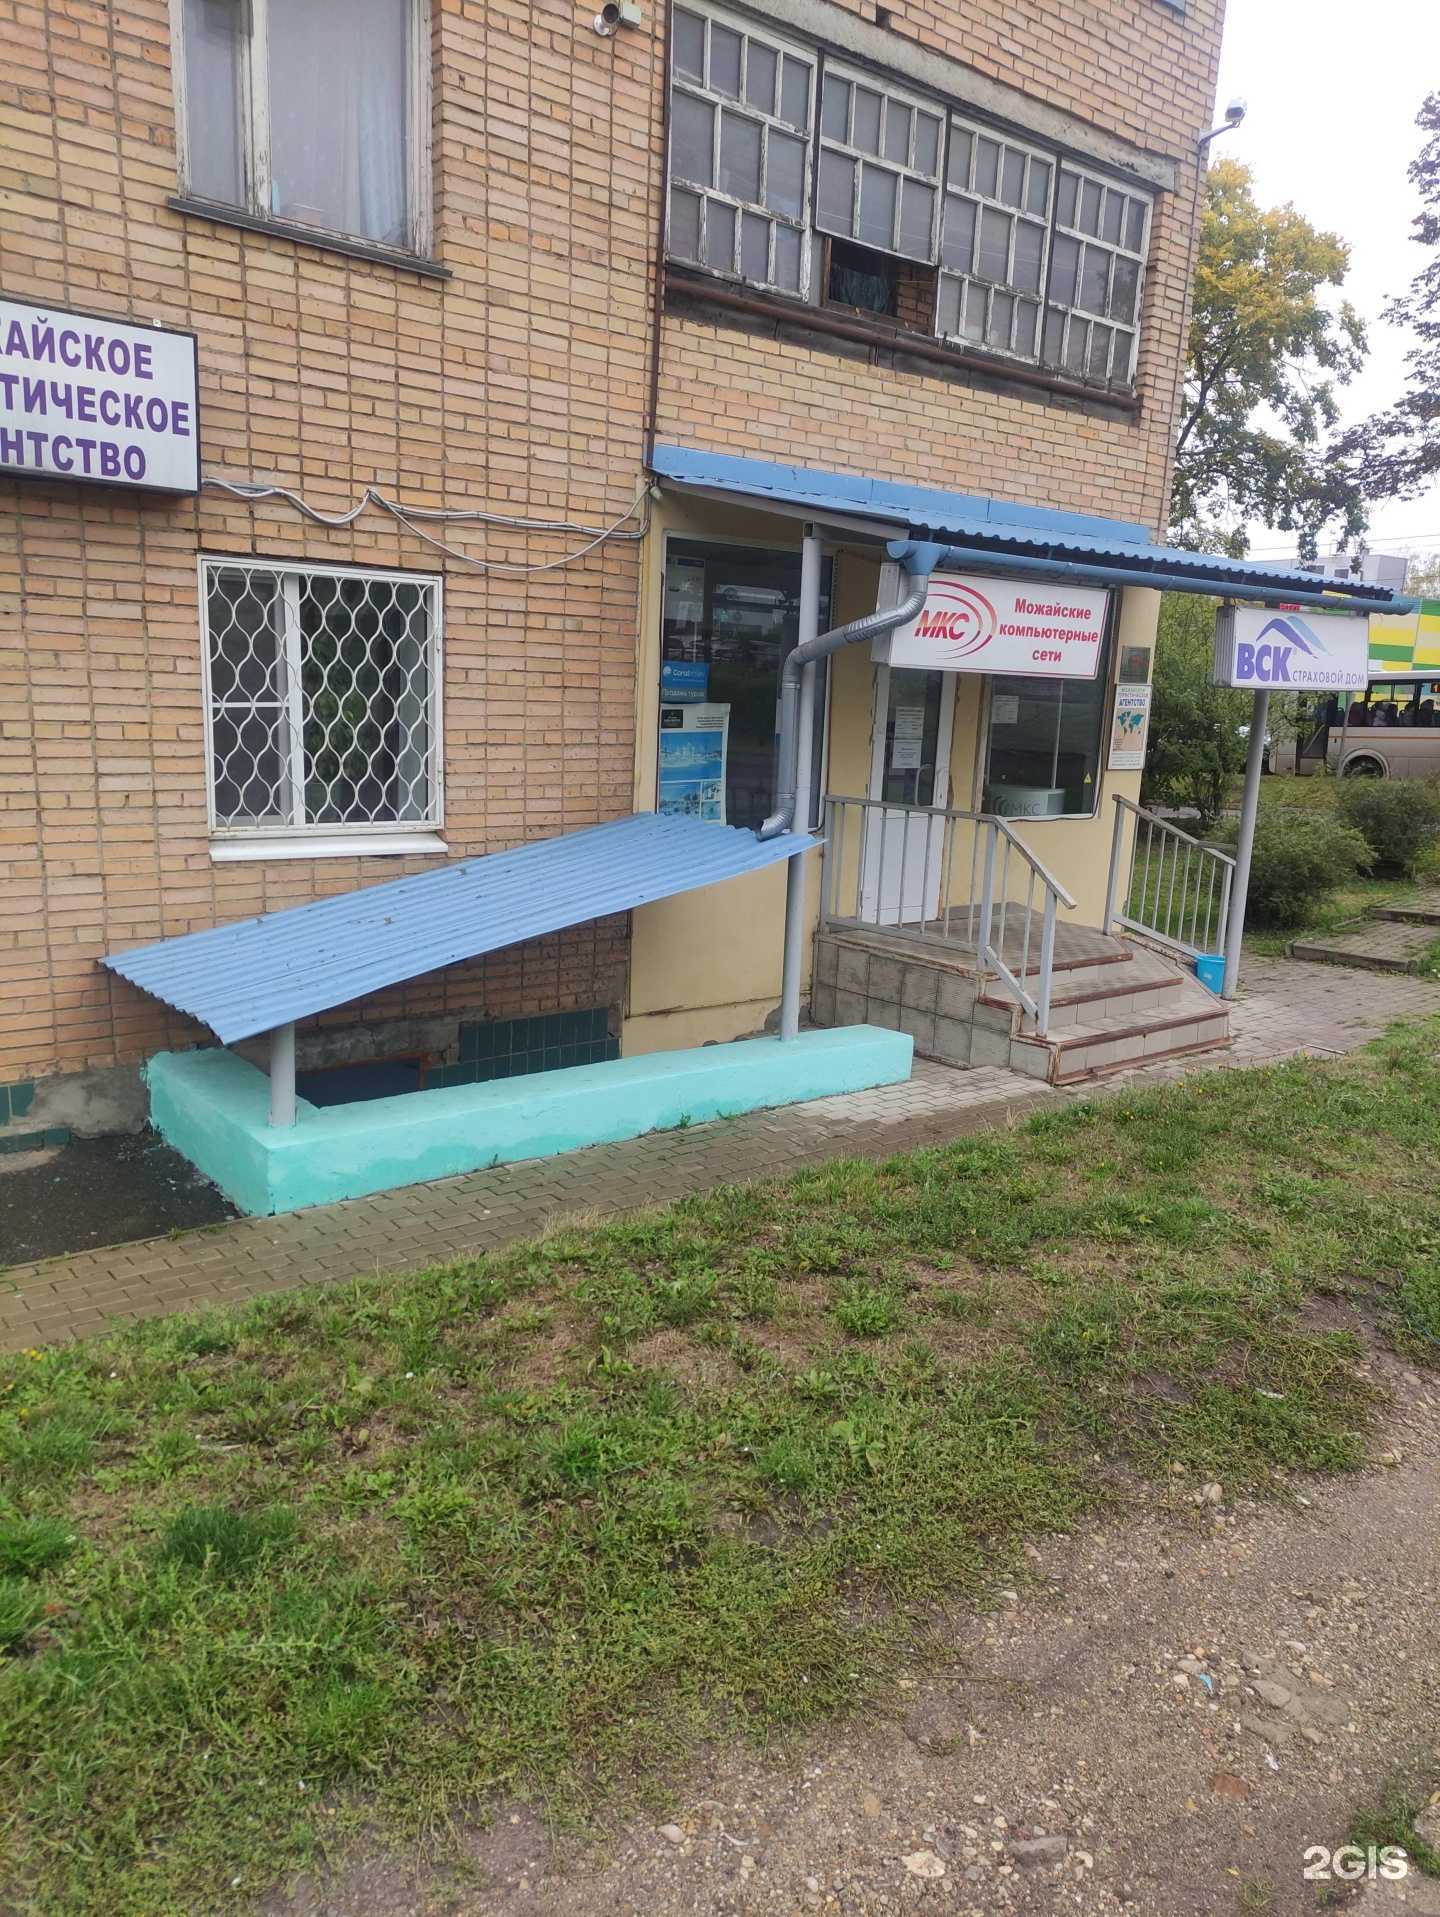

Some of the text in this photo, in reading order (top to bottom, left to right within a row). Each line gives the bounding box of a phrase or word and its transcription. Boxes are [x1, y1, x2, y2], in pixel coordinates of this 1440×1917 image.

[0, 427, 147, 481] НТСТВО
[1014, 597, 1092, 620] Можайские
[914, 609, 970, 641] МКС
[999, 623, 1099, 644] компьютерные
[1032, 649, 1062, 662] сети
[1236, 642, 1292, 682] ВСК
[1293, 669, 1364, 686] СТРАХОВОЙ ДОМ
